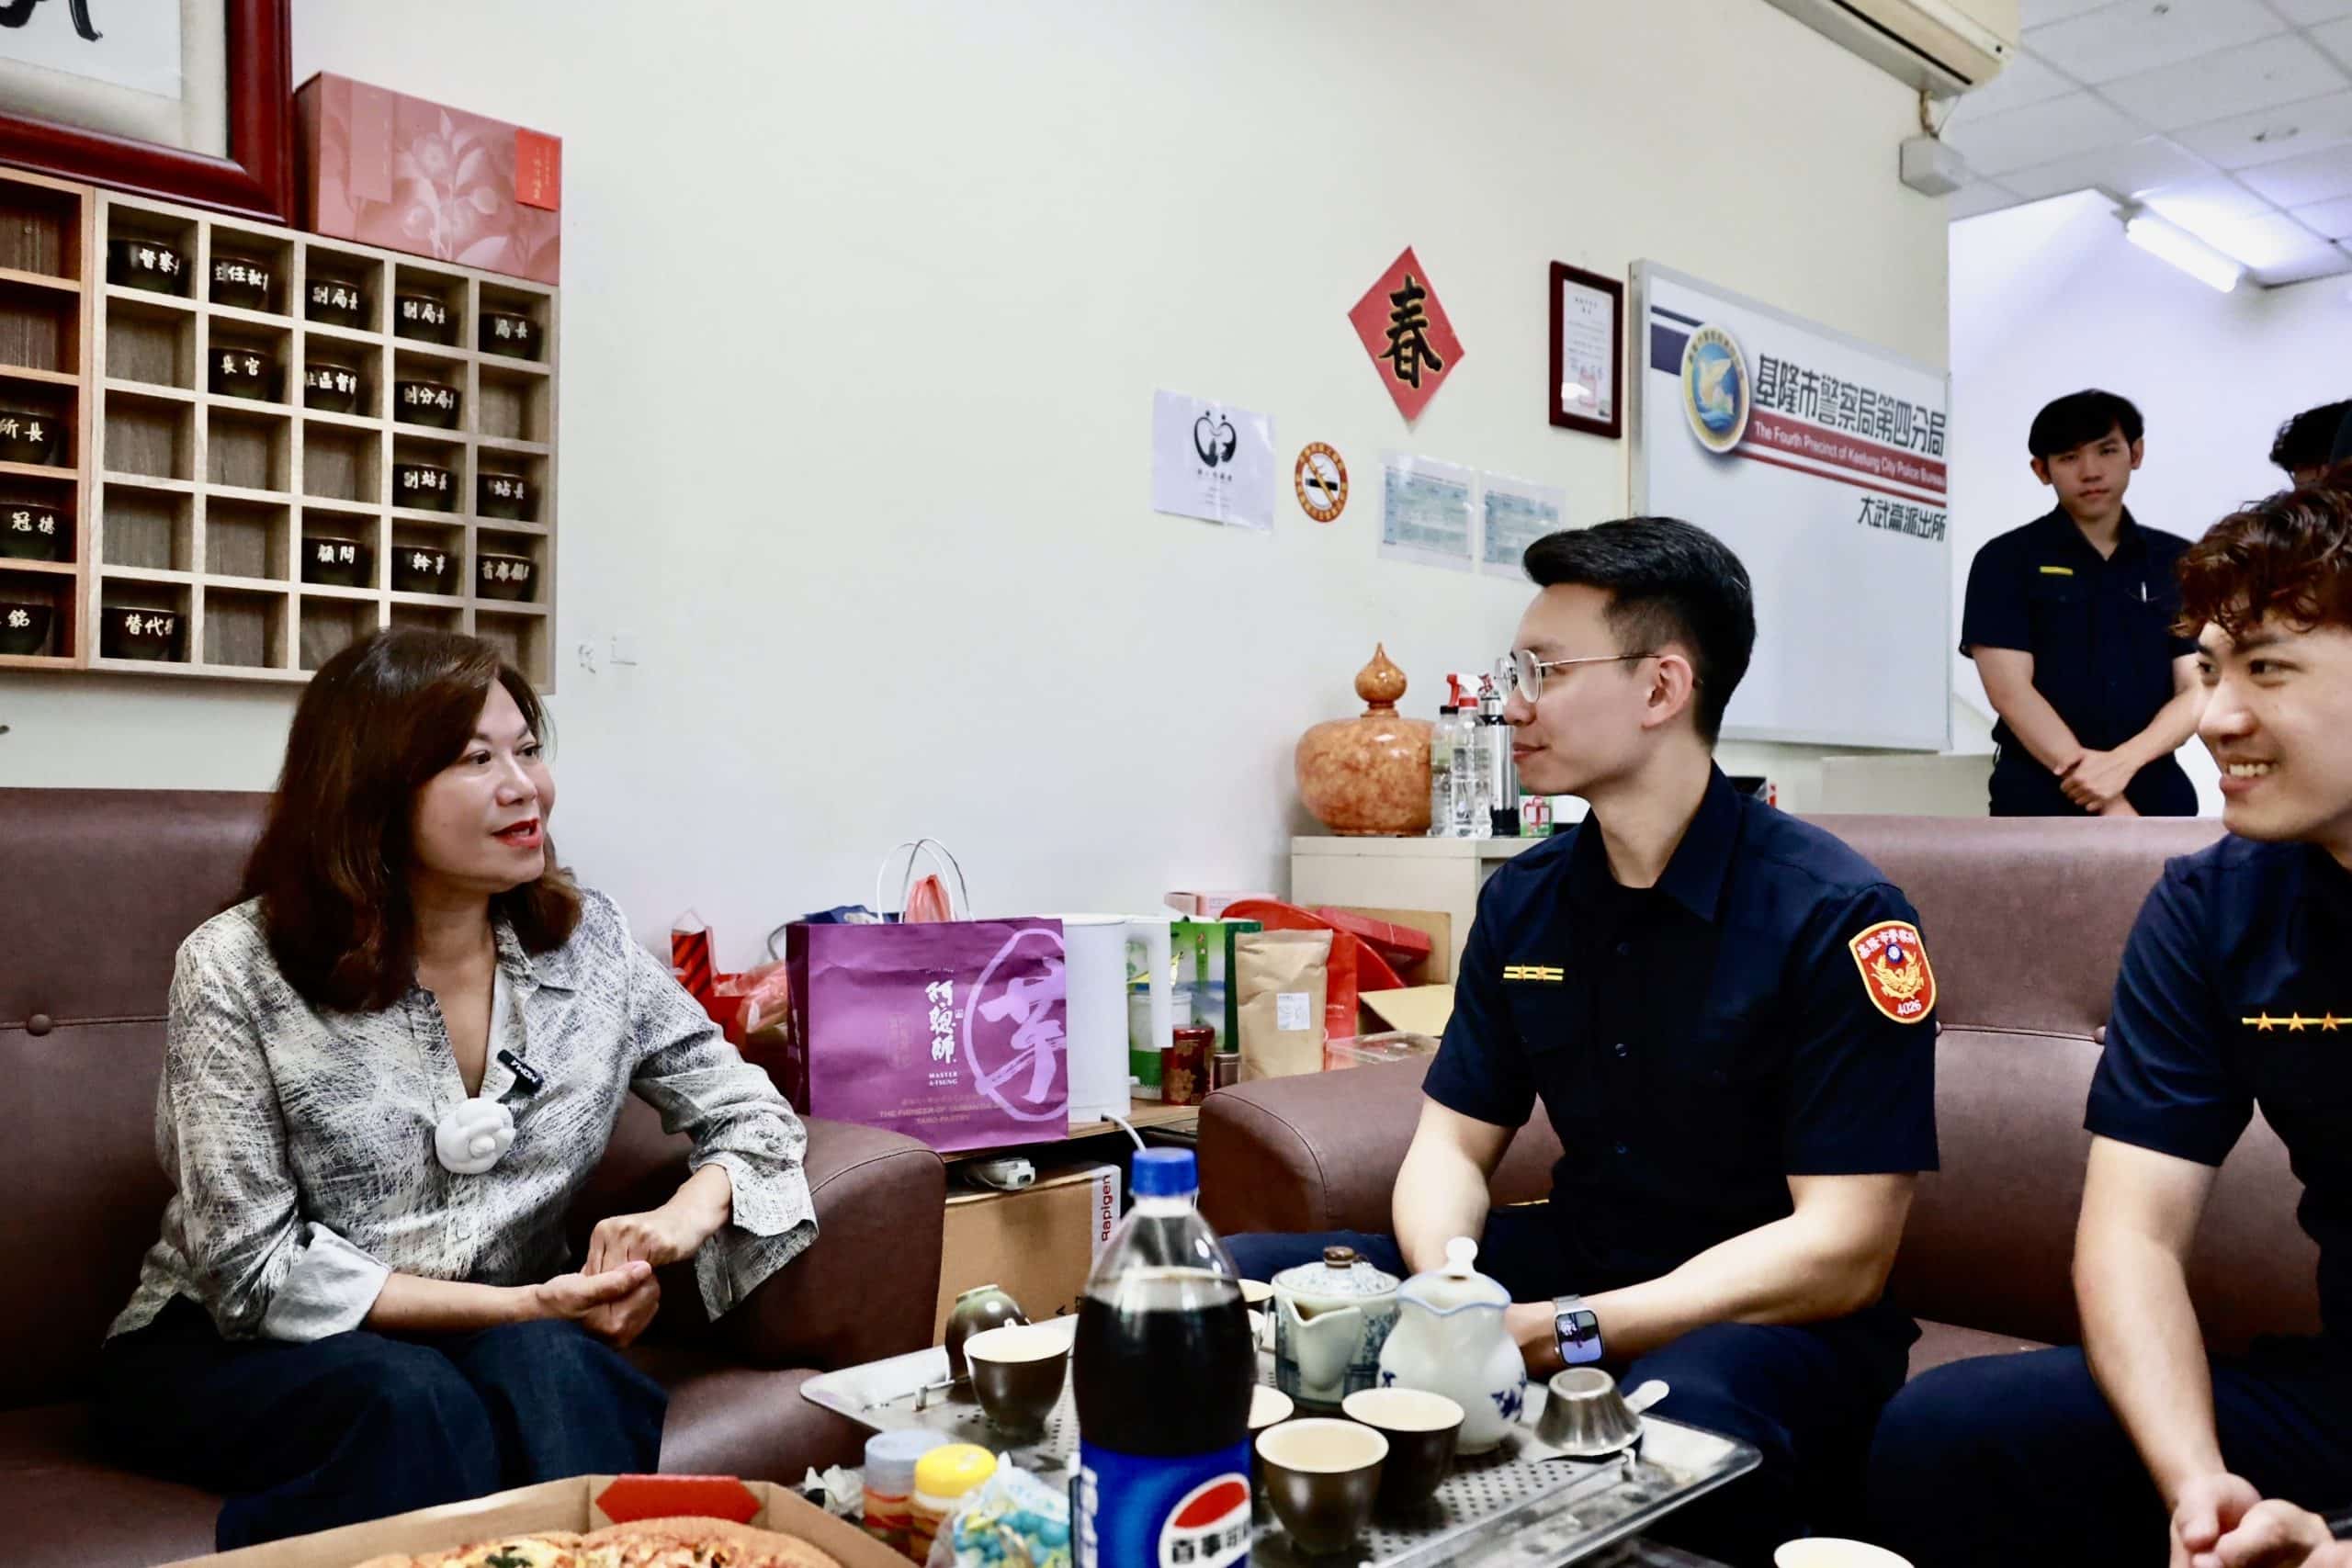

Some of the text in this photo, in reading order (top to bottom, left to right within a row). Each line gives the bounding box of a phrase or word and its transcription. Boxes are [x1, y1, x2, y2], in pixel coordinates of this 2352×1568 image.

[1379, 273, 1442, 389] 春
[1755, 353, 1947, 457] 基隆市警察局第四分局
[1754, 421, 1773, 442] The
[1774, 426, 1803, 448] Fourth
[1804, 434, 1838, 457] Precinct
[1838, 446, 1848, 457] of
[1883, 456, 1896, 478] City
[1897, 460, 1920, 480] Police
[0, 609, 30, 628] 銘
[929, 1071, 958, 1079] MASTER
[1101, 1175, 1114, 1242] Rapigen
